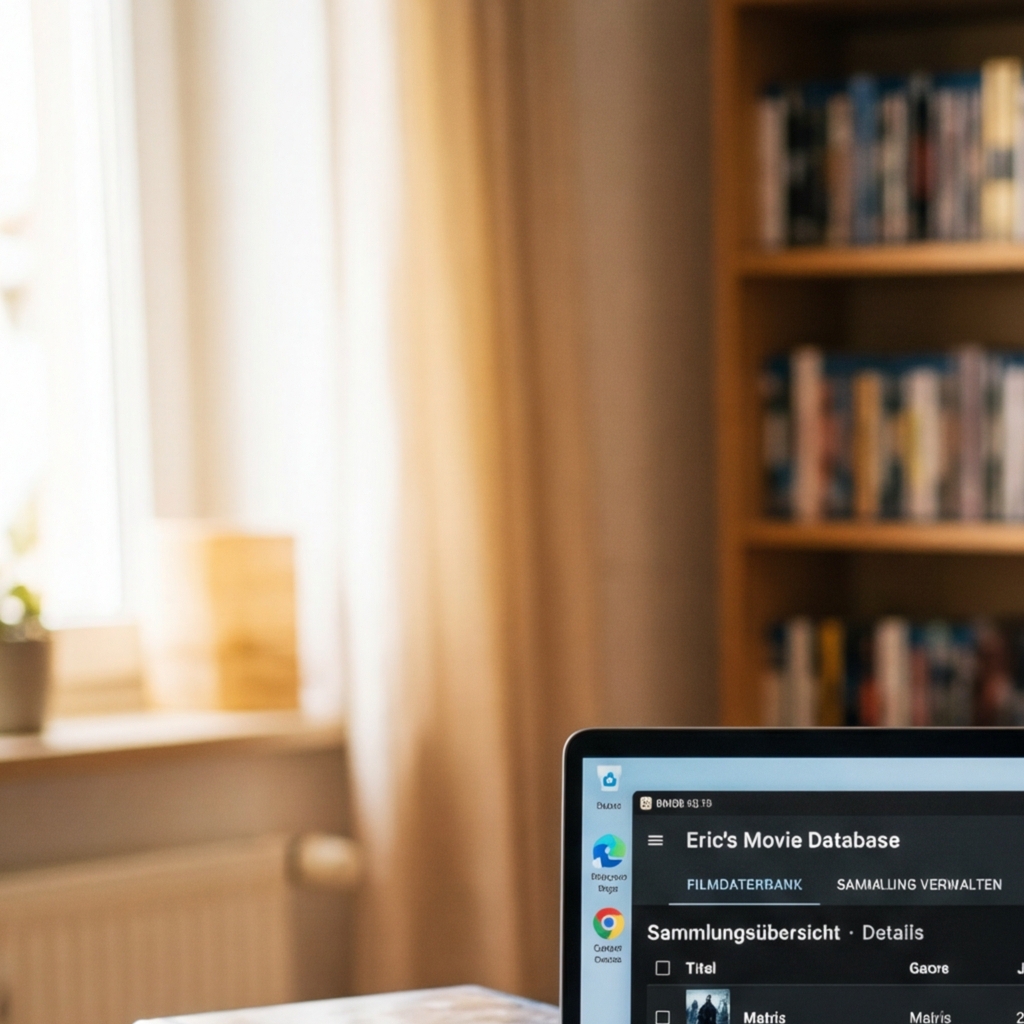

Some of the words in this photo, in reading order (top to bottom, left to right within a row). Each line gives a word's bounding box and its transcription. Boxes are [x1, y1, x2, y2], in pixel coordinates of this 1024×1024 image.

[686, 830, 738, 849] Eric's
[743, 830, 803, 849] Movie
[808, 830, 901, 849] Database
[920, 878, 1003, 891] VERWALTEN
[647, 923, 841, 945] Sammlungsübersicht
[862, 923, 925, 941] Details
